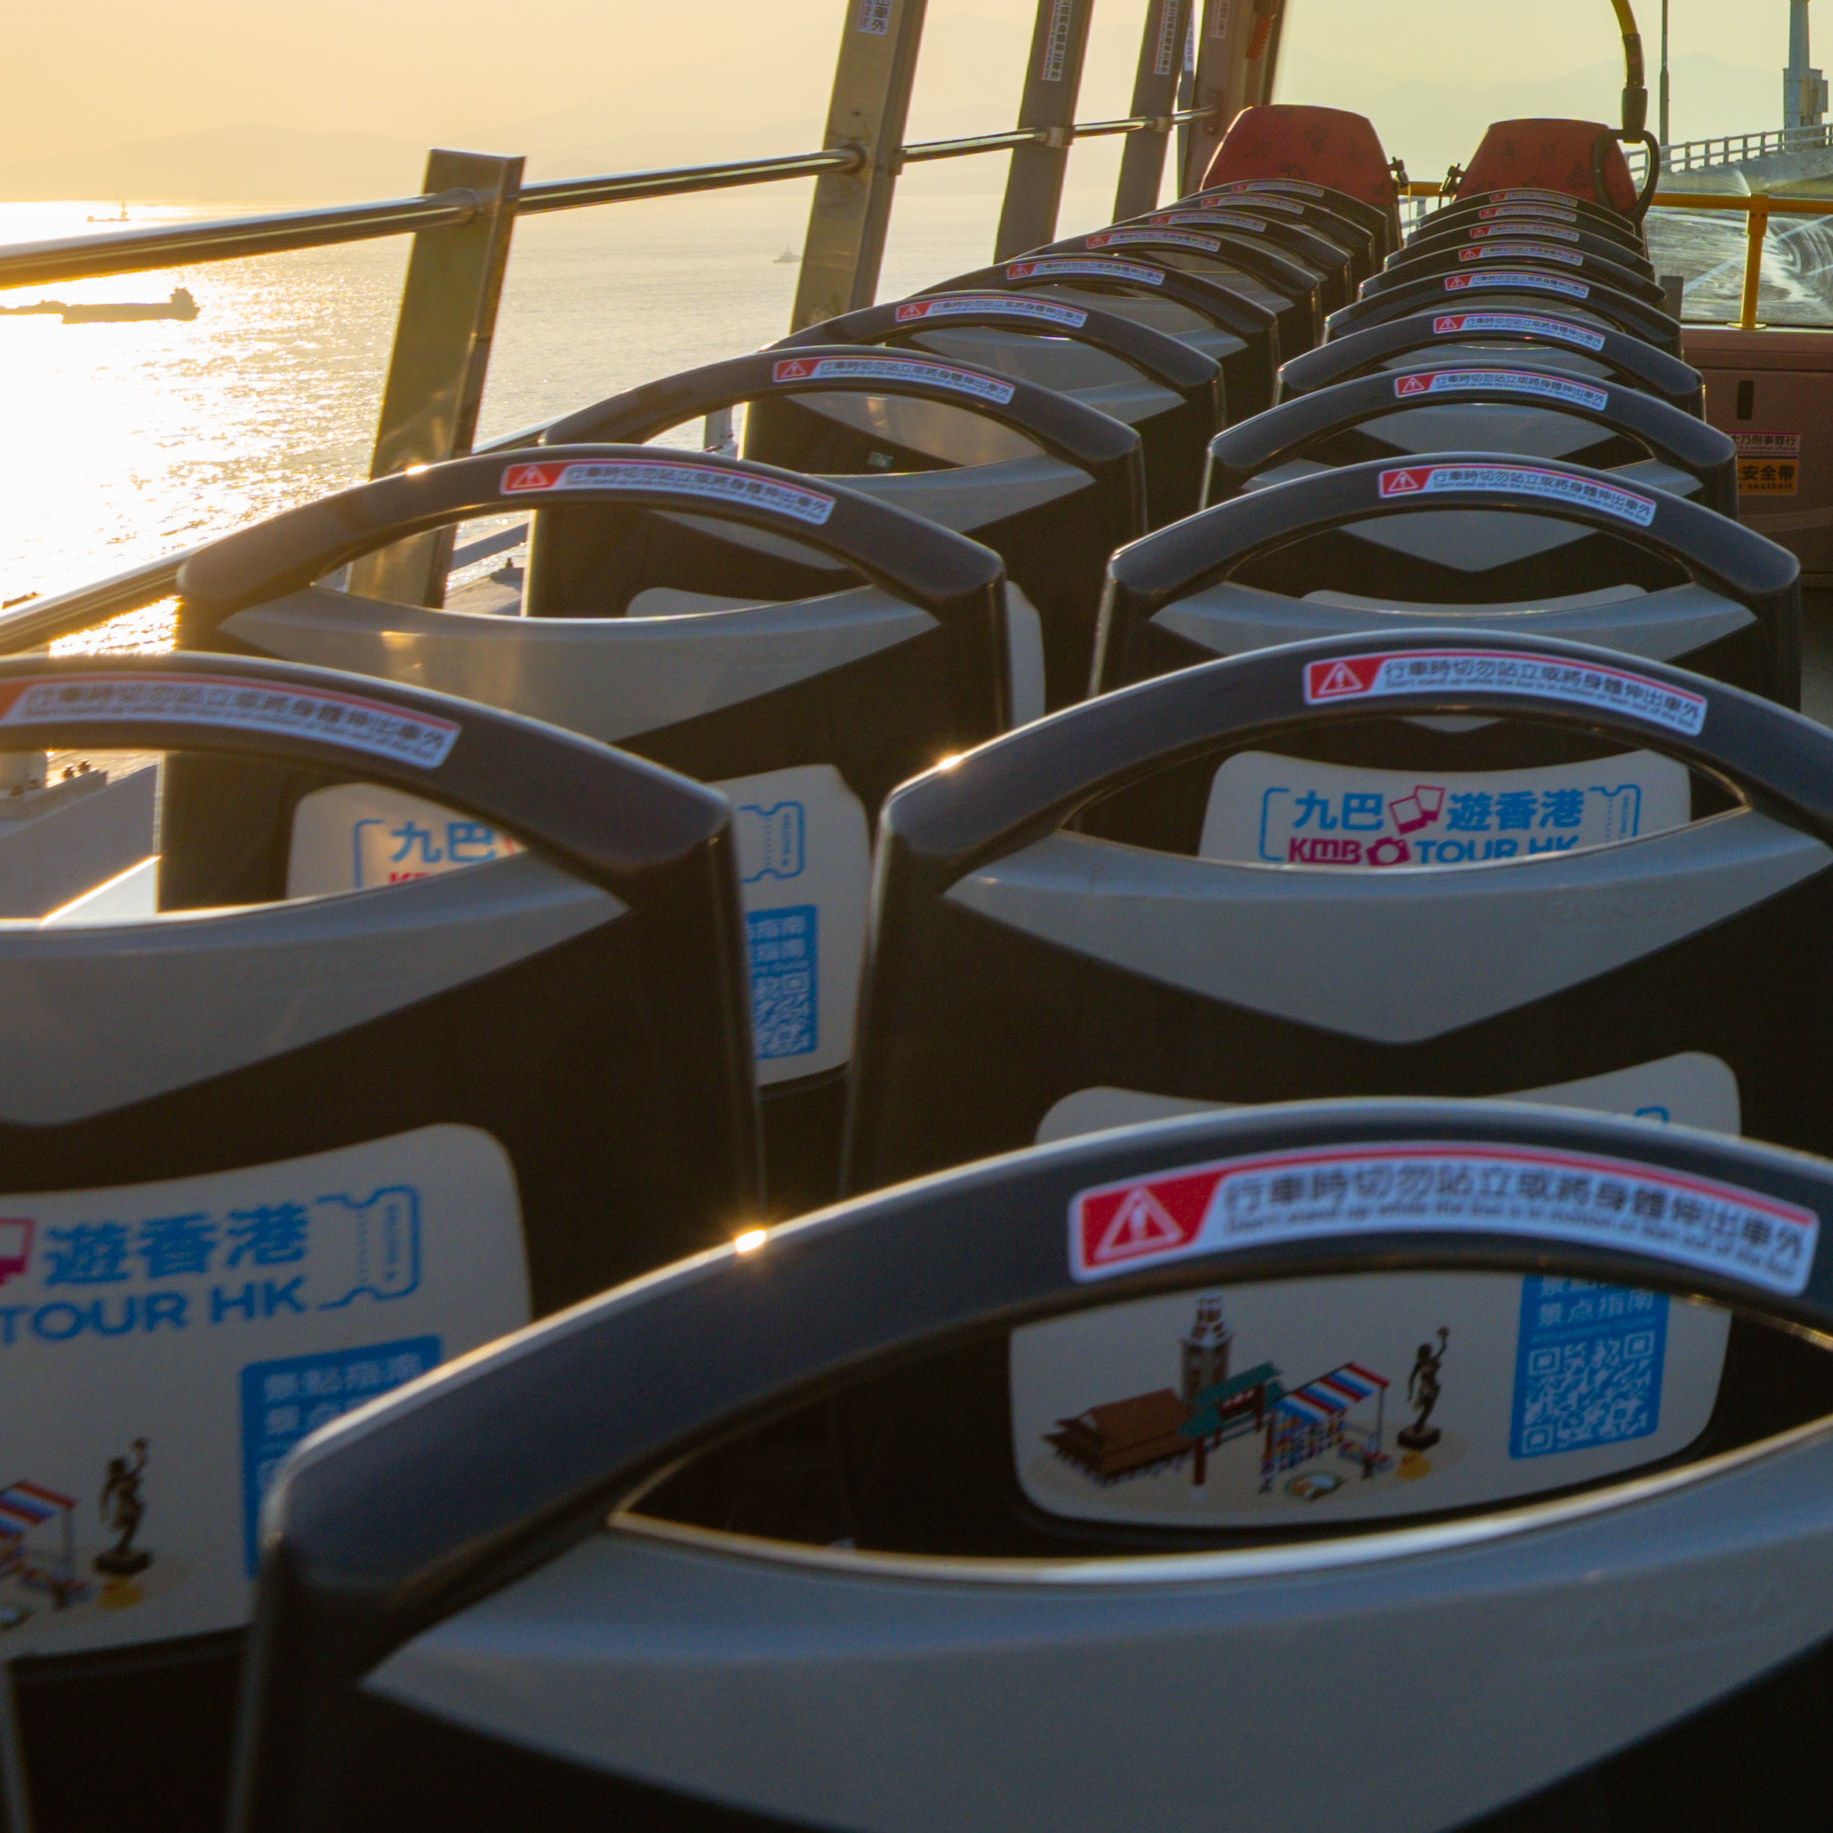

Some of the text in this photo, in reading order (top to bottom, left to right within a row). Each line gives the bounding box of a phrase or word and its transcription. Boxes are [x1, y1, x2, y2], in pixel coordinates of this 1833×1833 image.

[1738, 465, 1794, 481] 安全帶
[1384, 660, 1699, 719] 行車時切勿站立或將身體伸出車外
[1293, 789, 1584, 832] 九巴 遊香港
[390, 820, 498, 864] 九巴
[1288, 835, 1579, 865] KMB TOUR HK
[1225, 1161, 1804, 1258] 行車時切勿站立或將身體伸出車外
[43, 1201, 309, 1287] 遊香港
[0, 1277, 307, 1346] TOUR HK
